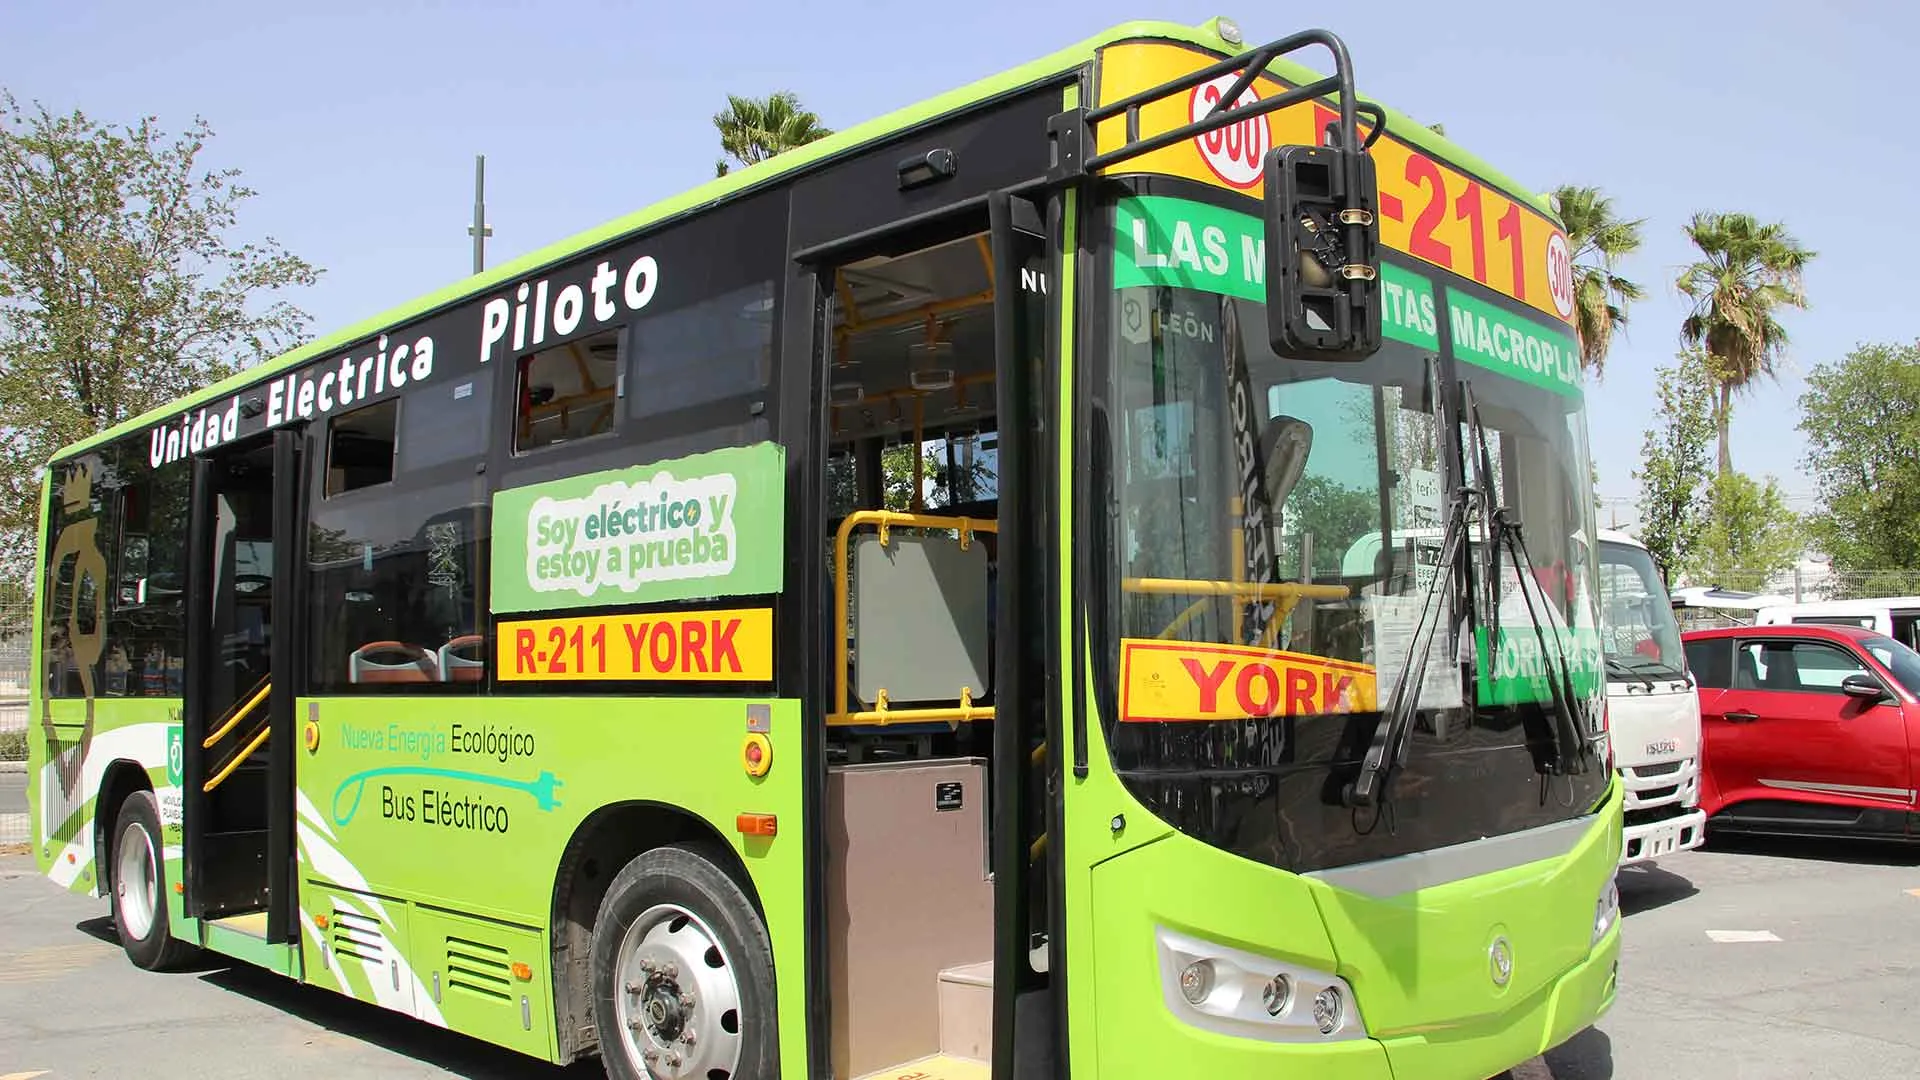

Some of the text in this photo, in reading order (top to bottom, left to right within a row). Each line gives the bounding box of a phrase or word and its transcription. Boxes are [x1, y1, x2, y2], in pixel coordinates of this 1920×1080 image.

[1132, 217, 1229, 276] LAS
[149, 255, 659, 470] Unidad Electrica Piloto
[1451, 305, 1582, 386] MACROPLA
[536, 491, 729, 553] Soy eléctrico y
[536, 528, 729, 583] estoy a prueba
[515, 618, 744, 674] R-211 YORK
[1179, 657, 1354, 717] YORK
[340, 722, 535, 762] Nueva Energía Ecológico
[382, 785, 509, 834] Bus Eléctrico
